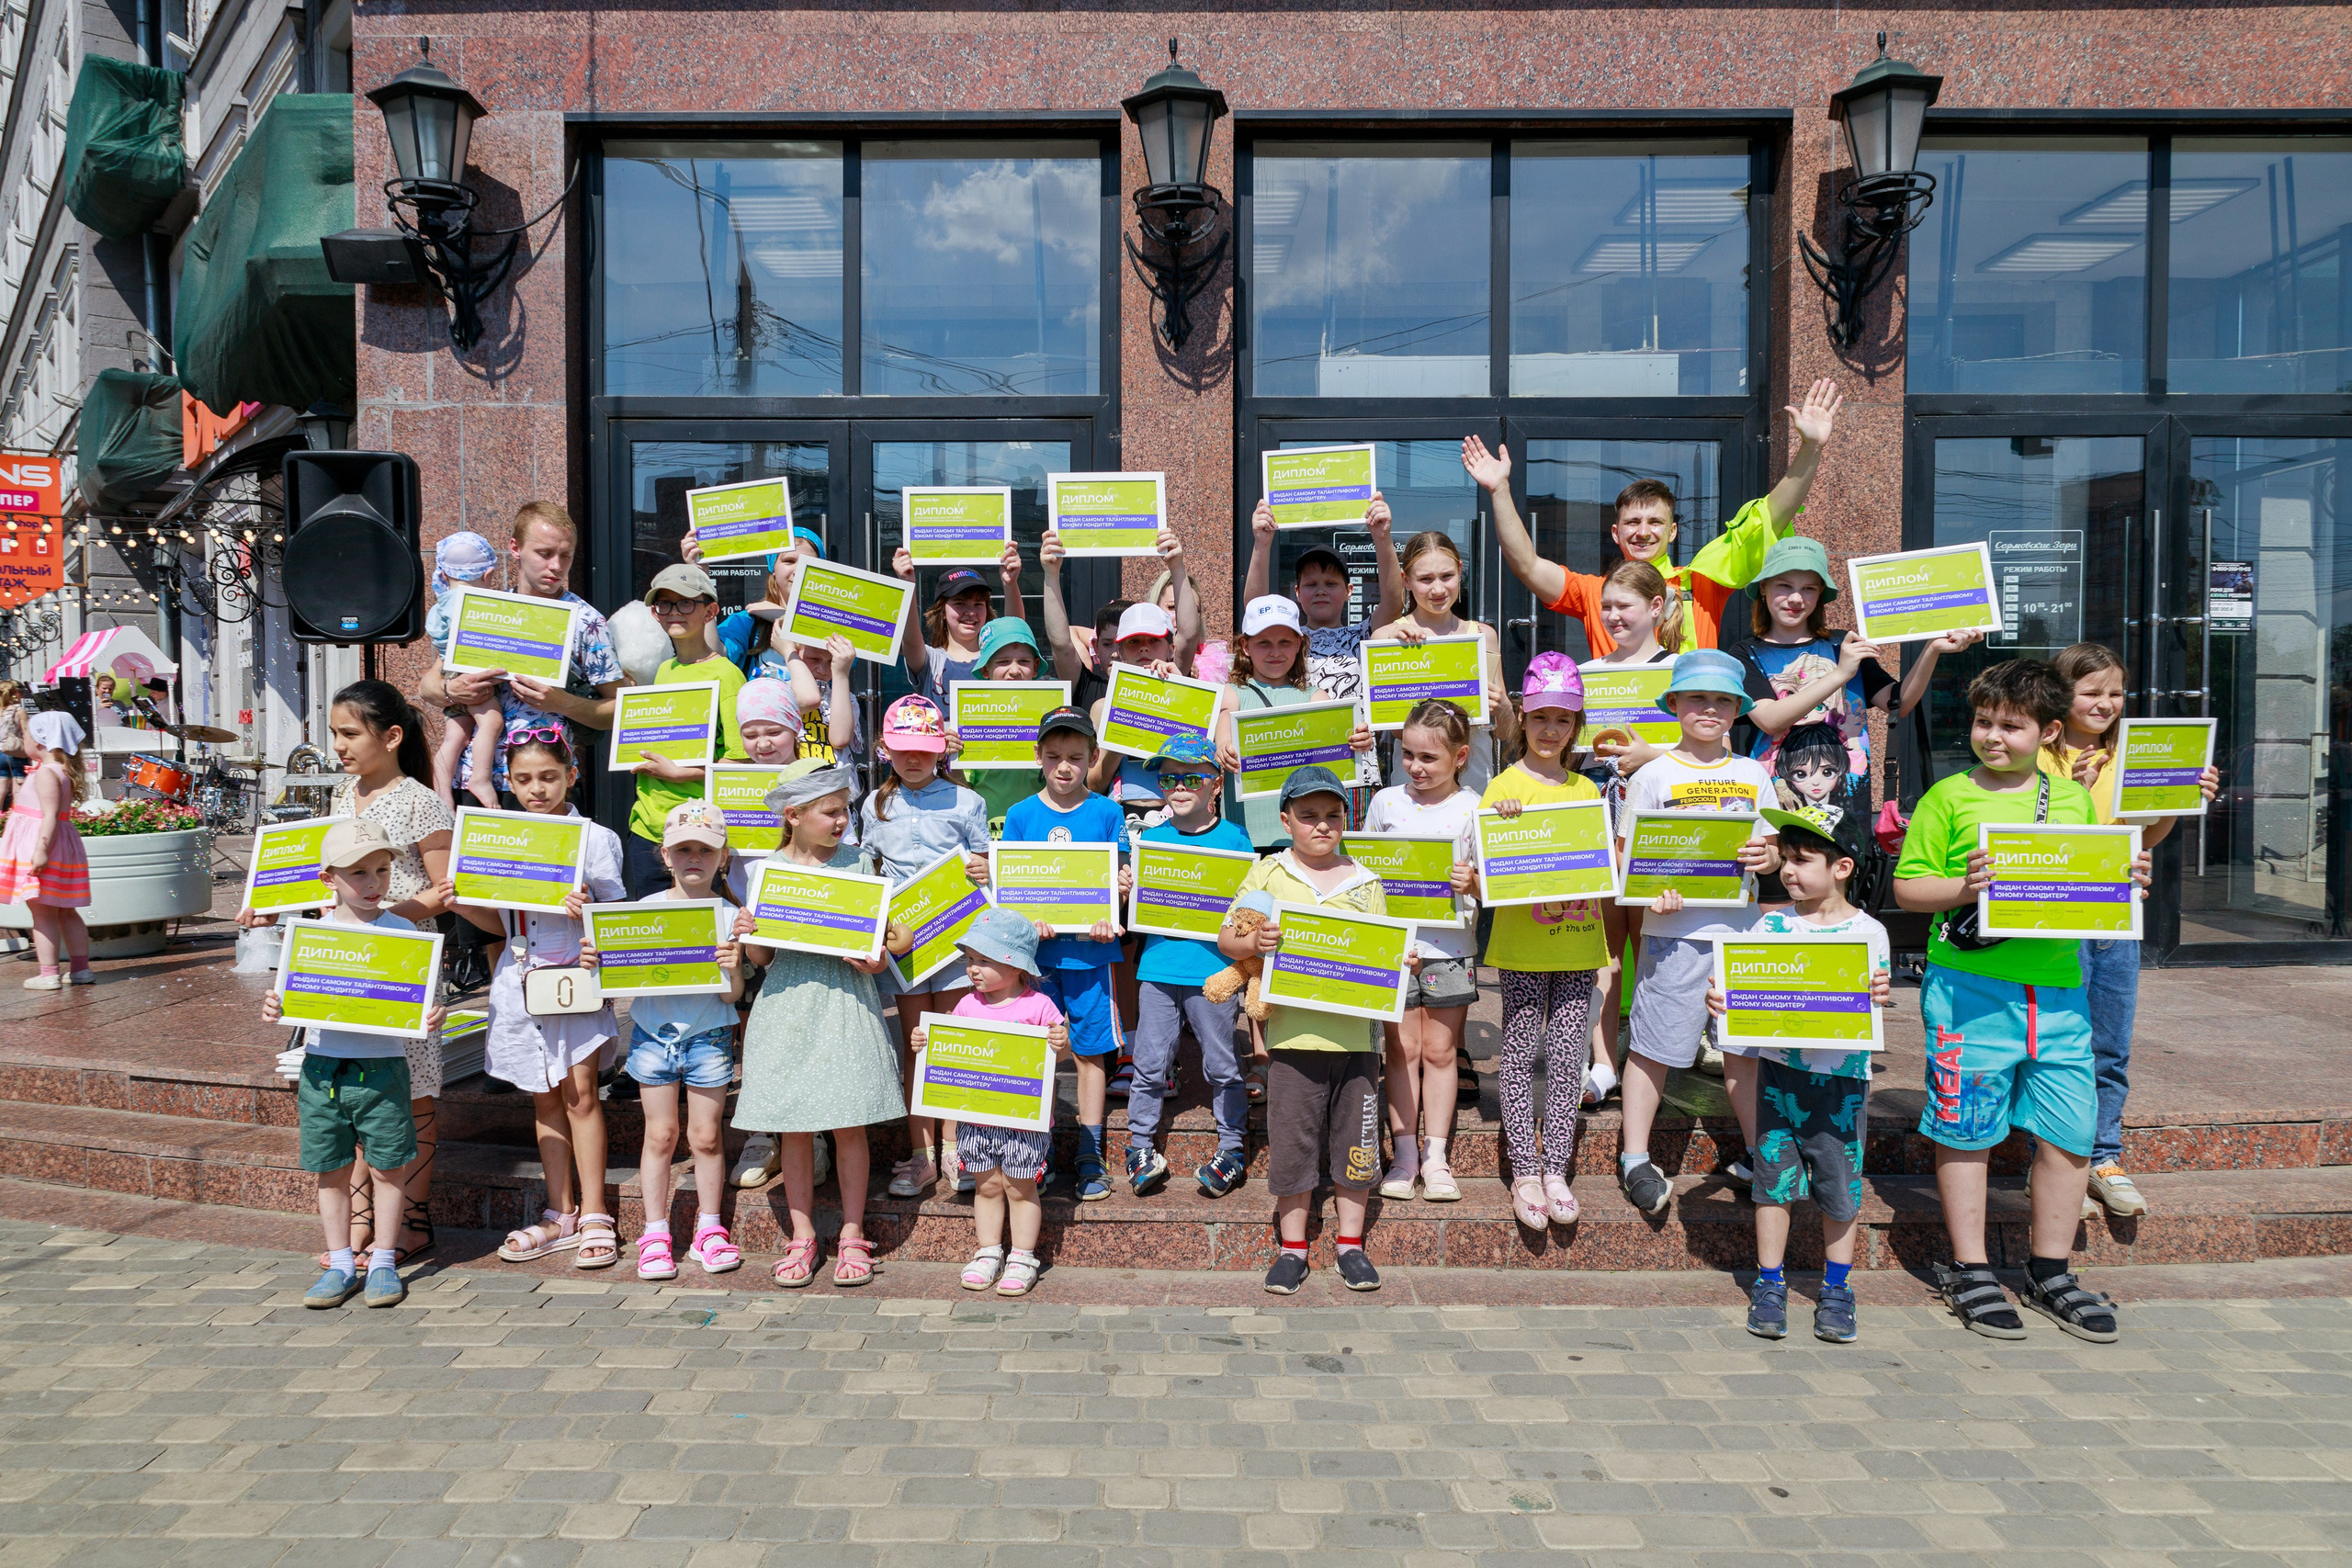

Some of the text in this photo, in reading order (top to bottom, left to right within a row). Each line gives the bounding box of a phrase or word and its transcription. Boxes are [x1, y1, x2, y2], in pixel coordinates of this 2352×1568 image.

[1272, 467, 1325, 479] ДИПЛОМ
[1061, 494, 1114, 504] ДИПЛОМ
[697, 502, 744, 517] ДИПЛОМ
[913, 506, 964, 516] ДИПЛОМ
[1995, 541, 2077, 554] Сормовские Зори
[1865, 572, 1929, 590] ДИПЛОМ
[804, 580, 859, 601] ДИПЛОМ
[465, 609, 523, 626] ДИПЛОМ
[798, 607, 852, 625] ЮНОМУ КОНДИТЕРУ
[799, 603, 886, 628] ВЫДАН САМОМУ ТАЛАНТЛИВОМУ
[1373, 660, 1430, 674] ДИПЛОМ
[1421, 682, 1467, 691] ТАЛАНТЛИВОМУ
[1117, 686, 1170, 706] ДИПЛОМ
[625, 705, 672, 718] ДИПЛОМ
[962, 704, 1017, 714] ДИПЛОМ
[1113, 716, 1164, 731] ЮНОМУ КОНДИТЕРУ
[1114, 710, 1198, 734] ВЫДАН САМОМУ ТАЛАНТЛИВОМУ
[1244, 727, 1304, 745] ДИПЛОМ
[1246, 747, 1341, 764] ВЫДАН САМОМУ ТАЛАНТЛИВОМУ
[2127, 742, 2172, 755] ДИПЛОМ
[1246, 757, 1305, 770] ЮНОМУ КОНДИТЕРУ
[1687, 787, 1749, 795] GENERATION
[1680, 796, 1716, 805] FEROCIOUS
[466, 832, 527, 847] ДИПЛОМ
[1487, 828, 1552, 844] ДИПЛОМ
[1636, 834, 1700, 845] ДИПЛОМ
[262, 843, 307, 859] ДИПЛОМ
[1994, 852, 2068, 865] ДИПЛОМ
[462, 858, 485, 866] ВЫДАН
[513, 863, 563, 874] ТАЛАНТЛИВОМУ
[1489, 852, 1595, 867] ВЫДАН САМОМУ ТАЛАНТЛИВОМУ
[486, 867, 524, 875] КОНДИТЕРУ
[1001, 864, 1060, 875] ДИПЛОМ
[1143, 864, 1202, 881] ДИПЛОМ
[1490, 863, 1555, 874] ЮНОМУ КОНДИТЕРУ
[764, 883, 829, 899] ДИПЛОМ
[1163, 892, 1189, 900] САМОМУ
[1190, 896, 1232, 907] ТАЛАНТЛИВОМ
[758, 910, 823, 924] ЮНОМУ КОНДИТЕРУ
[760, 905, 865, 924] ВЫДАН САМОМУ ТАЛАНТЛИВОМУ
[892, 897, 932, 927] ИПЛОМ
[932, 897, 972, 927] ТАЛАНТЛИВОМУ
[599, 924, 663, 939] ДИПЛОМ
[1549, 923, 1595, 935] of the box
[1283, 928, 1350, 948] ДИПЛОМ
[296, 945, 370, 964] ДИПЛОМ
[1278, 962, 1345, 977] ЮНОМУ КОНДИТЕРУ
[1279, 955, 1387, 977] ВЫДАН САМОМУ ТАЛАНТЛИВОМУ
[1730, 962, 1804, 975] ДИПЛОМ
[291, 982, 365, 995] ЮНОМУ КОНДИТЕРУ
[292, 975, 412, 992] ВЫДАН САМОМУ ТАЛАНТЛИВОМУ
[1792, 994, 1855, 1002] ТАЛАНТЛИВОМУ
[932, 1041, 994, 1058] ДИПЛОМ
[929, 1068, 1031, 1087] ВЫДАН САМОМУ ТАЛАНТЛИВОМУ
[1935, 1023, 1963, 1123] HEAT
[929, 1075, 991, 1088] ЮНОМУ КОНДИТЕРУ
